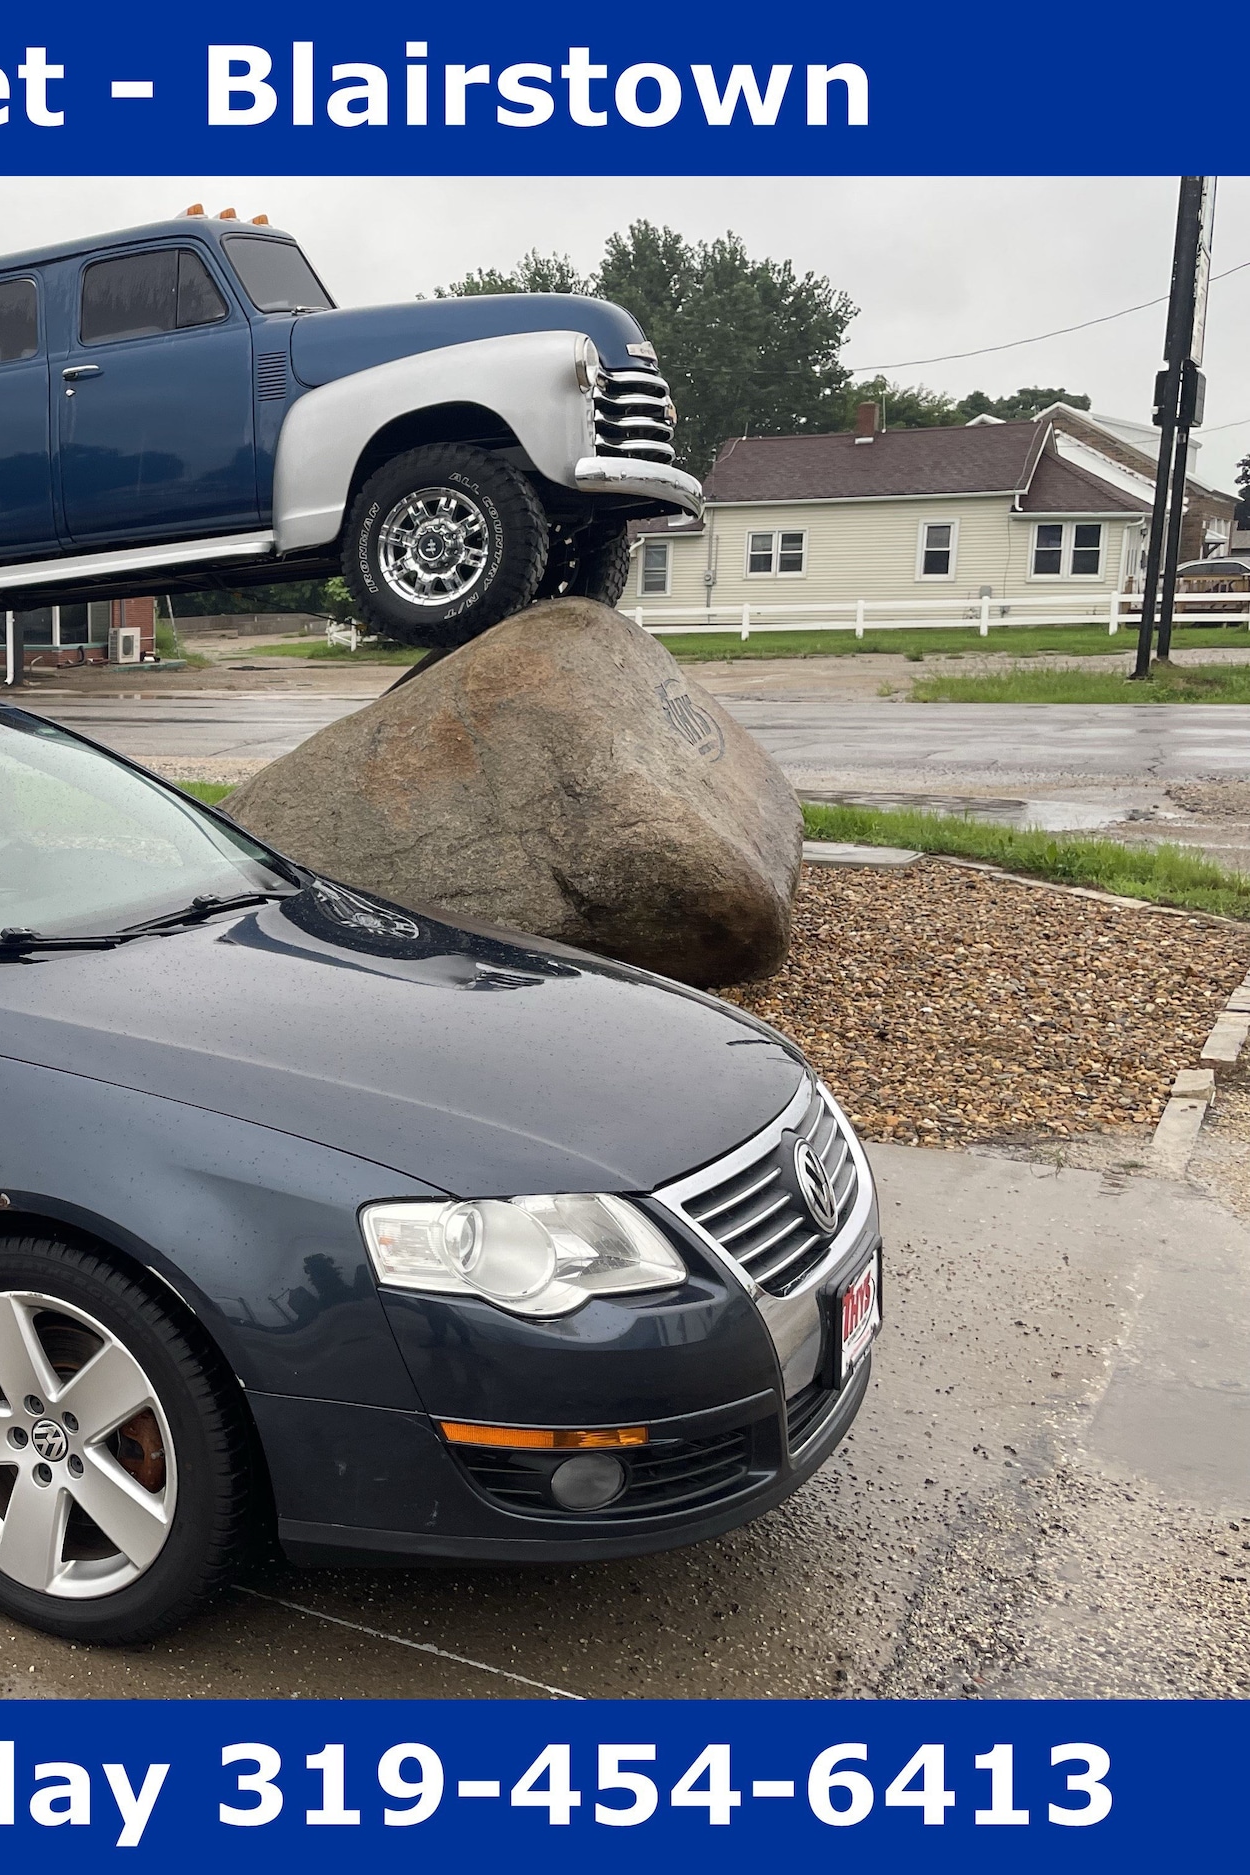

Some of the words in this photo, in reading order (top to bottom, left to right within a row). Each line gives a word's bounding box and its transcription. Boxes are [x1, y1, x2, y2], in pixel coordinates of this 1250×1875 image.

[448, 471, 481, 495] ALL
[358, 502, 380, 594] IRONMAN
[482, 495, 504, 591] COUNTRY
[444, 591, 480, 620] M/T
[842, 1269, 872, 1343] THYS
